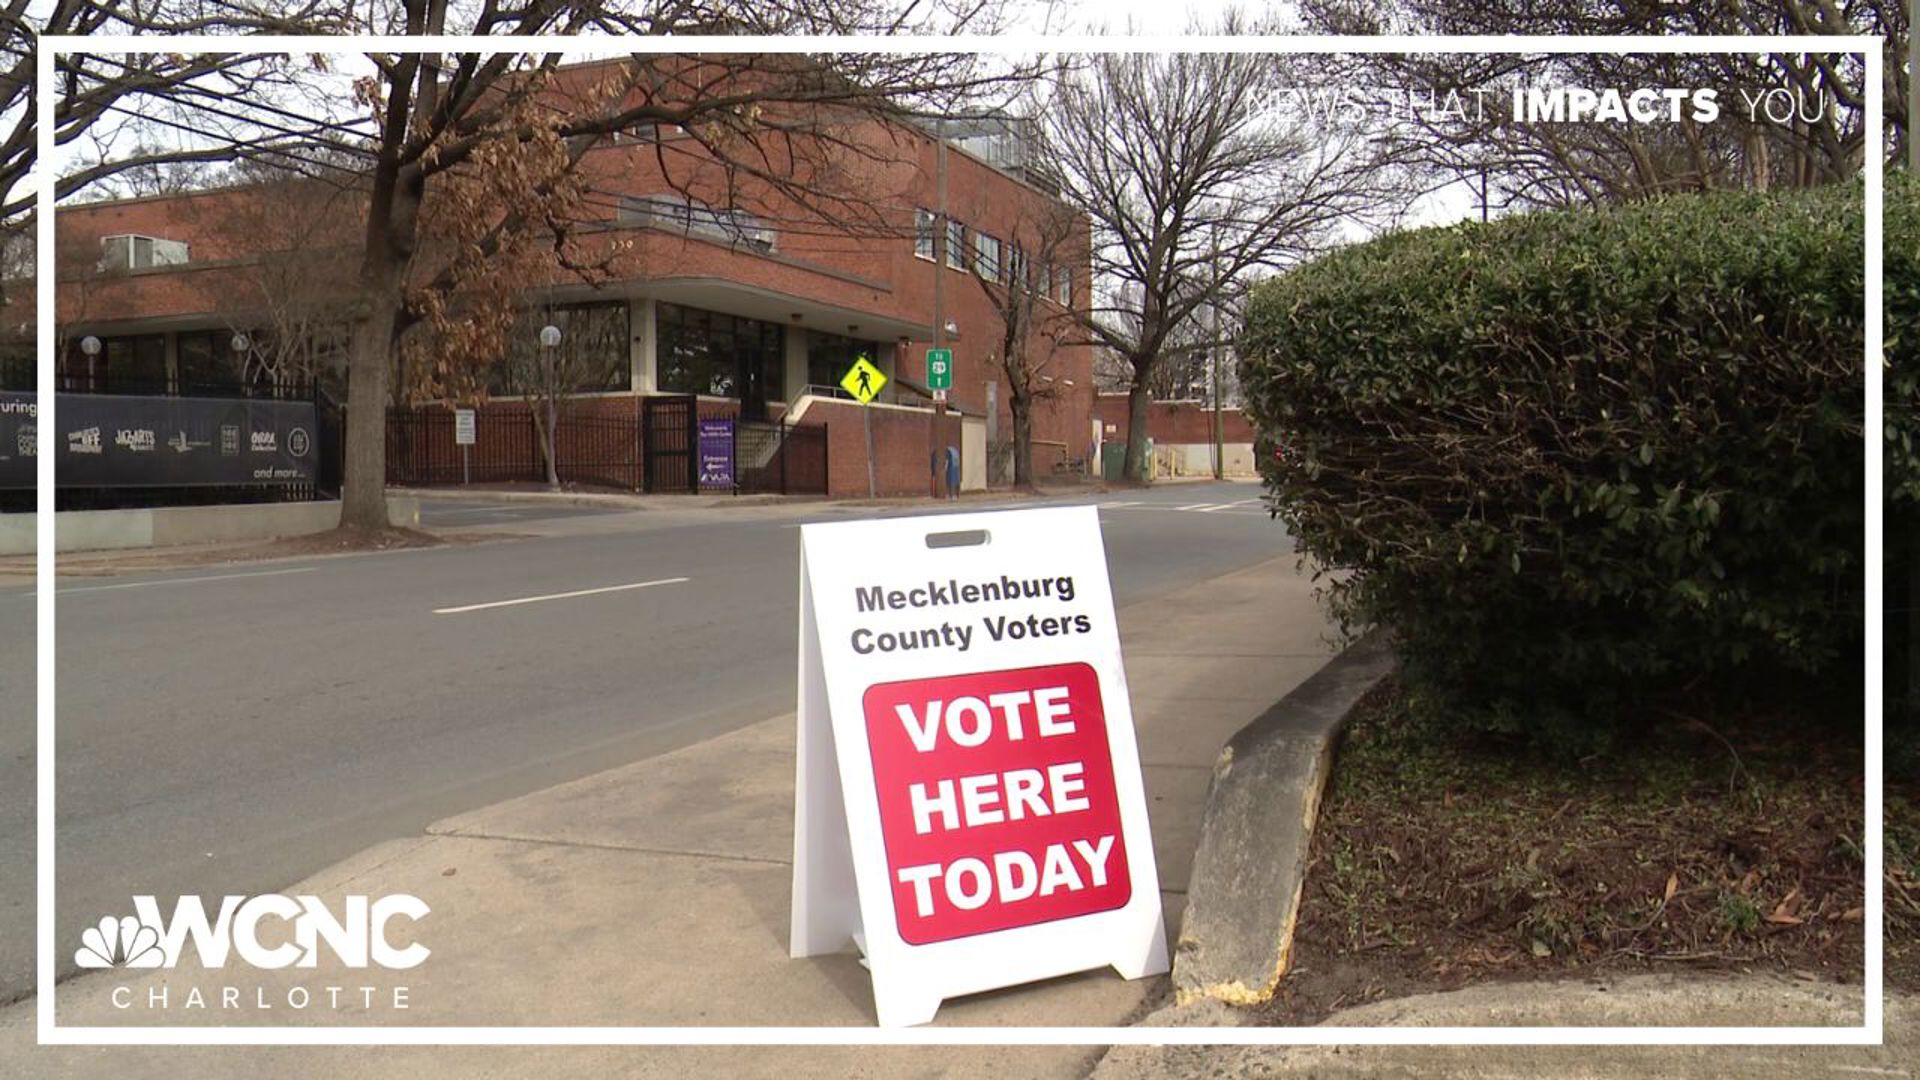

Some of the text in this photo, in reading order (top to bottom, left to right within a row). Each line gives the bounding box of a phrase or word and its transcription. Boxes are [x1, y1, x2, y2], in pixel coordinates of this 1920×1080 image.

[253, 466, 273, 478] and
[855, 575, 1075, 612] Mecklenburg
[851, 613, 1092, 655] County Voters
[895, 686, 1075, 753] VOTE
[908, 762, 1090, 835] HERE
[898, 836, 1116, 918] TODAY
